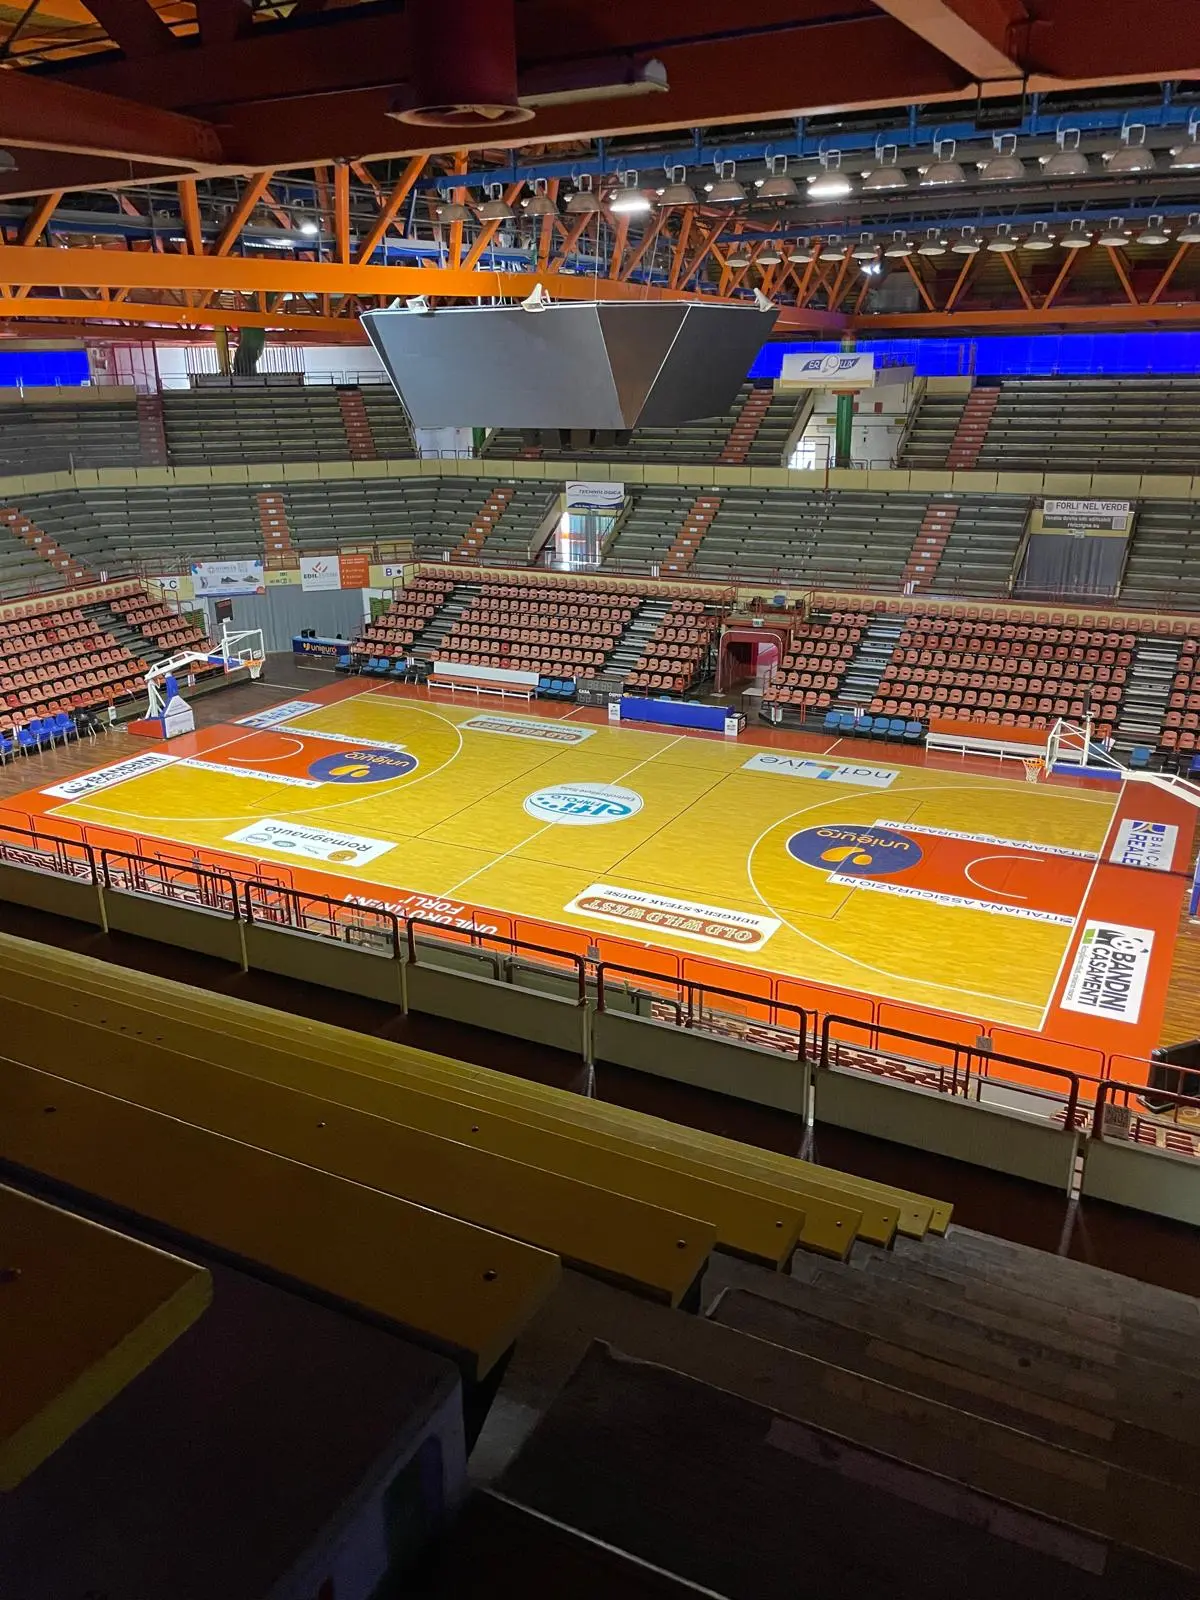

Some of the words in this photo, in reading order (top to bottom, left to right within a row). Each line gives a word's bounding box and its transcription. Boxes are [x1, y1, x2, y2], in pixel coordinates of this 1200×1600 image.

[1082, 502, 1100, 510] NEL
[1101, 503, 1128, 512] VERDE
[344, 751, 410, 768] unieuro
[264, 824, 374, 853] Romagnauto
[816, 829, 911, 851] unieuro
[1121, 832, 1148, 866] REALE
[603, 889, 647, 902] HOUSE
[648, 899, 694, 912] STEAK
[582, 898, 646, 920] WEST
[703, 909, 761, 926] BURGER
[645, 912, 702, 932] WILD
[705, 924, 753, 942] OLD
[1077, 946, 1107, 1008] CASAMENTI
[1100, 951, 1137, 1013] BANDINI
